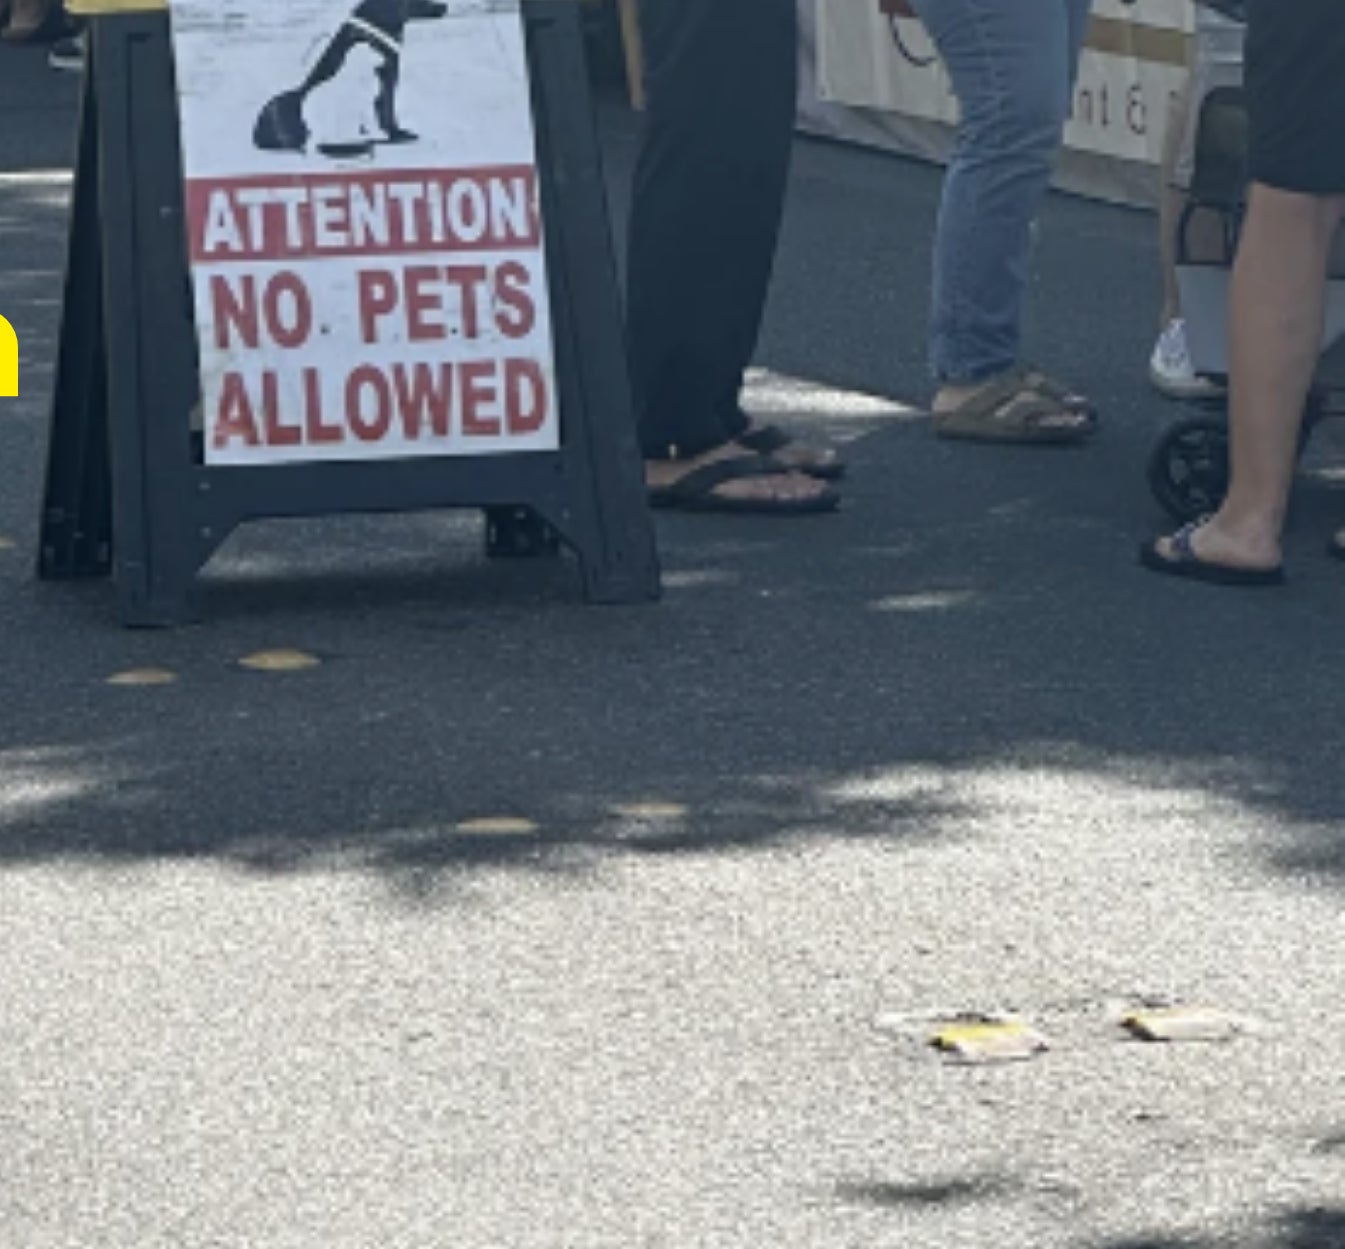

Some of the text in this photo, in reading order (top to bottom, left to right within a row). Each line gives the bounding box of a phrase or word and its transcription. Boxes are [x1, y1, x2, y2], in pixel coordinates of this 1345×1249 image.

[203, 177, 531, 252] ATTENTION
[209, 260, 536, 350] NO PETS
[212, 357, 549, 449] ALLOWED
